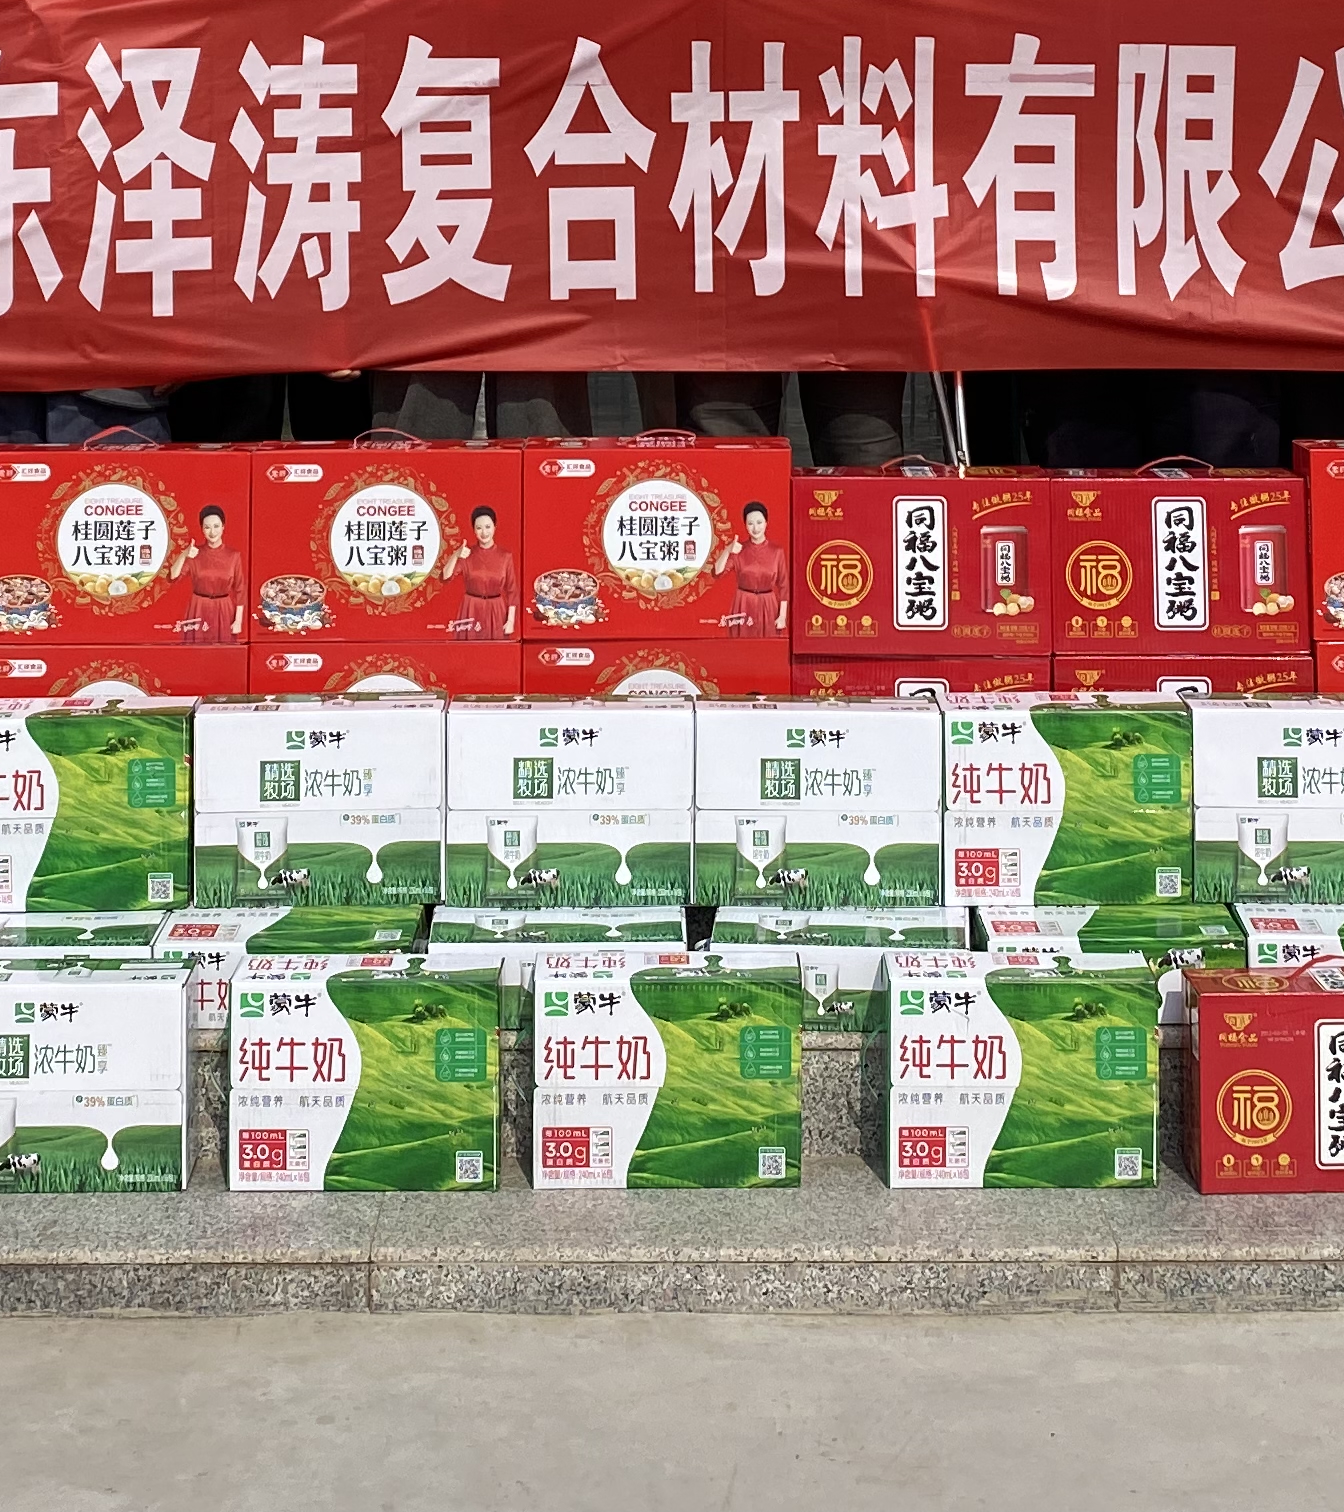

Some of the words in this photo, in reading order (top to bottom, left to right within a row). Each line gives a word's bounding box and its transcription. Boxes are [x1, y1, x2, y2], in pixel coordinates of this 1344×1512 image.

[84, 505, 143, 516] CONGEE
[356, 505, 415, 516] CONGEE
[629, 500, 687, 512] CONGEE
[71, 521, 156, 541] 桂圆莲子
[344, 521, 428, 541] 桂圆莲子
[616, 516, 700, 537] 桂圆莲子
[72, 544, 135, 567] 八宝粥
[345, 544, 408, 567] 八宝粥
[617, 540, 680, 562] 八宝粥
[820, 554, 863, 595] 福
[903, 505, 940, 621] 同福八宝粥
[1162, 505, 1200, 622] 同福八宝粥
[1080, 555, 1122, 596] 福
[309, 730, 347, 749] 蒙牛
[562, 728, 599, 747] 蒙牛
[809, 729, 846, 748] 蒙牛
[978, 722, 1022, 744] 蒙牛
[1306, 728, 1343, 747] 蒙牛
[304, 769, 362, 797] 浓牛奶
[558, 767, 614, 795] 浓牛奶
[805, 768, 861, 796] 浓牛奶
[952, 763, 1051, 804] 纯牛奶
[39, 1003, 80, 1022] 蒙牛
[269, 993, 316, 1016] 蒙牛
[574, 992, 621, 1015] 蒙牛
[929, 991, 977, 1015] 蒙牛
[34, 1044, 95, 1074] 浓牛奶
[239, 1037, 345, 1082] 纯牛奶
[544, 1035, 651, 1080] 纯牛奶
[899, 1035, 1006, 1080] 纯牛奶
[1232, 1086, 1279, 1131] 福
